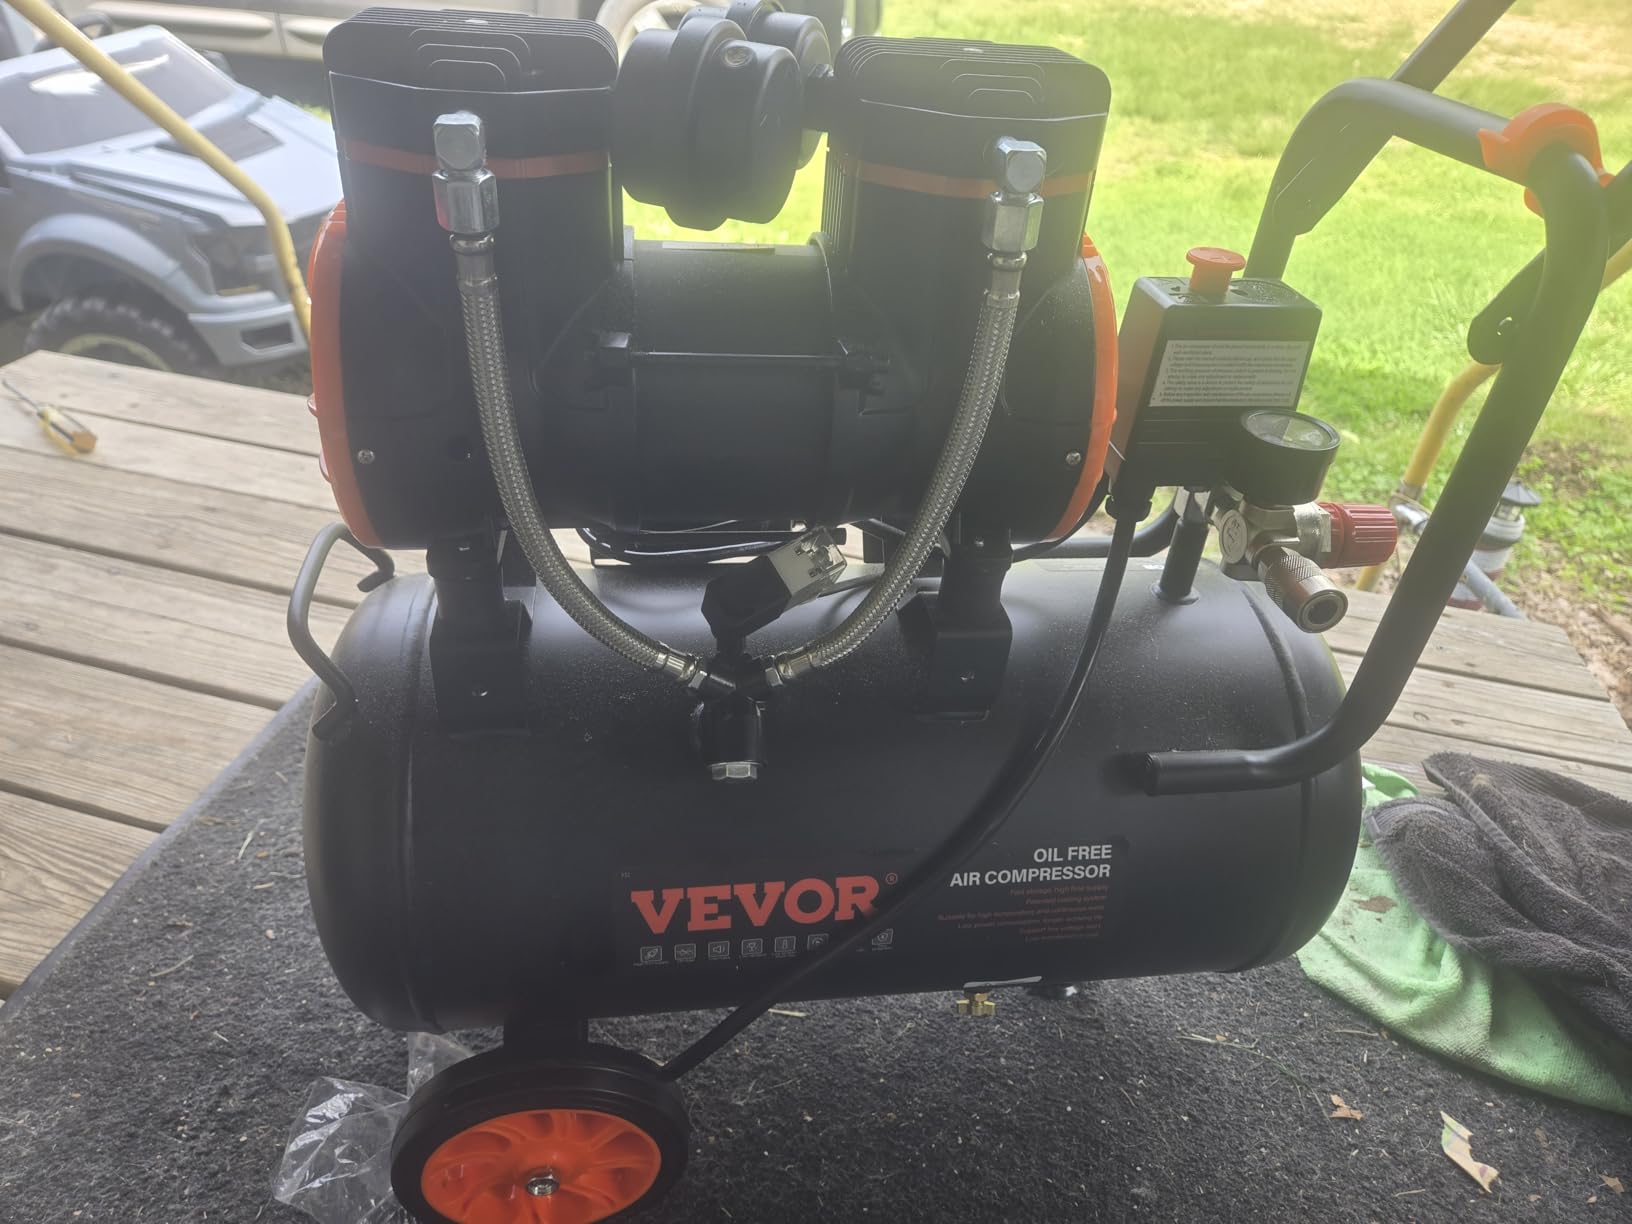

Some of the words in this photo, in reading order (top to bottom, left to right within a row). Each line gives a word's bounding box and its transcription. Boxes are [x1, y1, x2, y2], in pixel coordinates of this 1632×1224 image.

[1033, 847, 1064, 863] OIL
[1067, 844, 1113, 861] FREE
[949, 871, 981, 887] AIR
[984, 864, 1112, 885] COMPRESSOR
